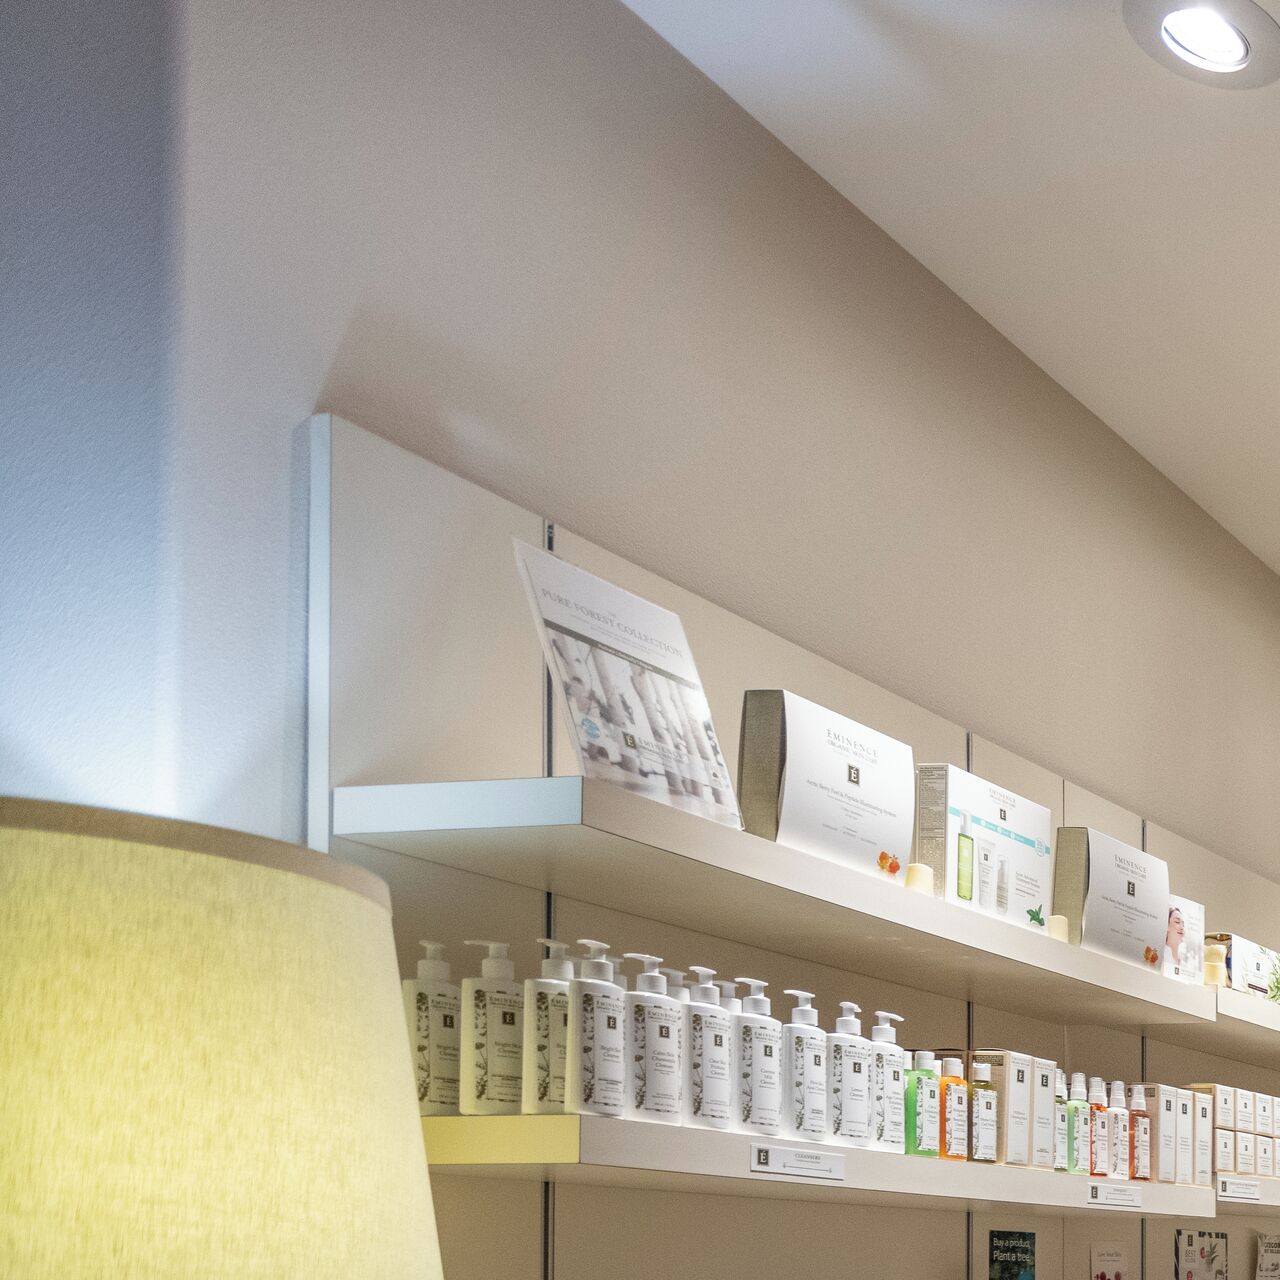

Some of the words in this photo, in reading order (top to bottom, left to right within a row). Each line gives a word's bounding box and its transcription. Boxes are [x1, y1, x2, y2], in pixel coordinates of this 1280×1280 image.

[542, 588, 573, 609] PURE
[574, 603, 615, 627] FOREST
[617, 622, 682, 658] COLLECTION
[827, 727, 878, 758] ÉMINENCE
[993, 1237, 1004, 1248] Buy
[993, 1250, 1011, 1261] Plant
[1011, 1253, 1017, 1261] a
[1184, 1249, 1196, 1258] BEST
